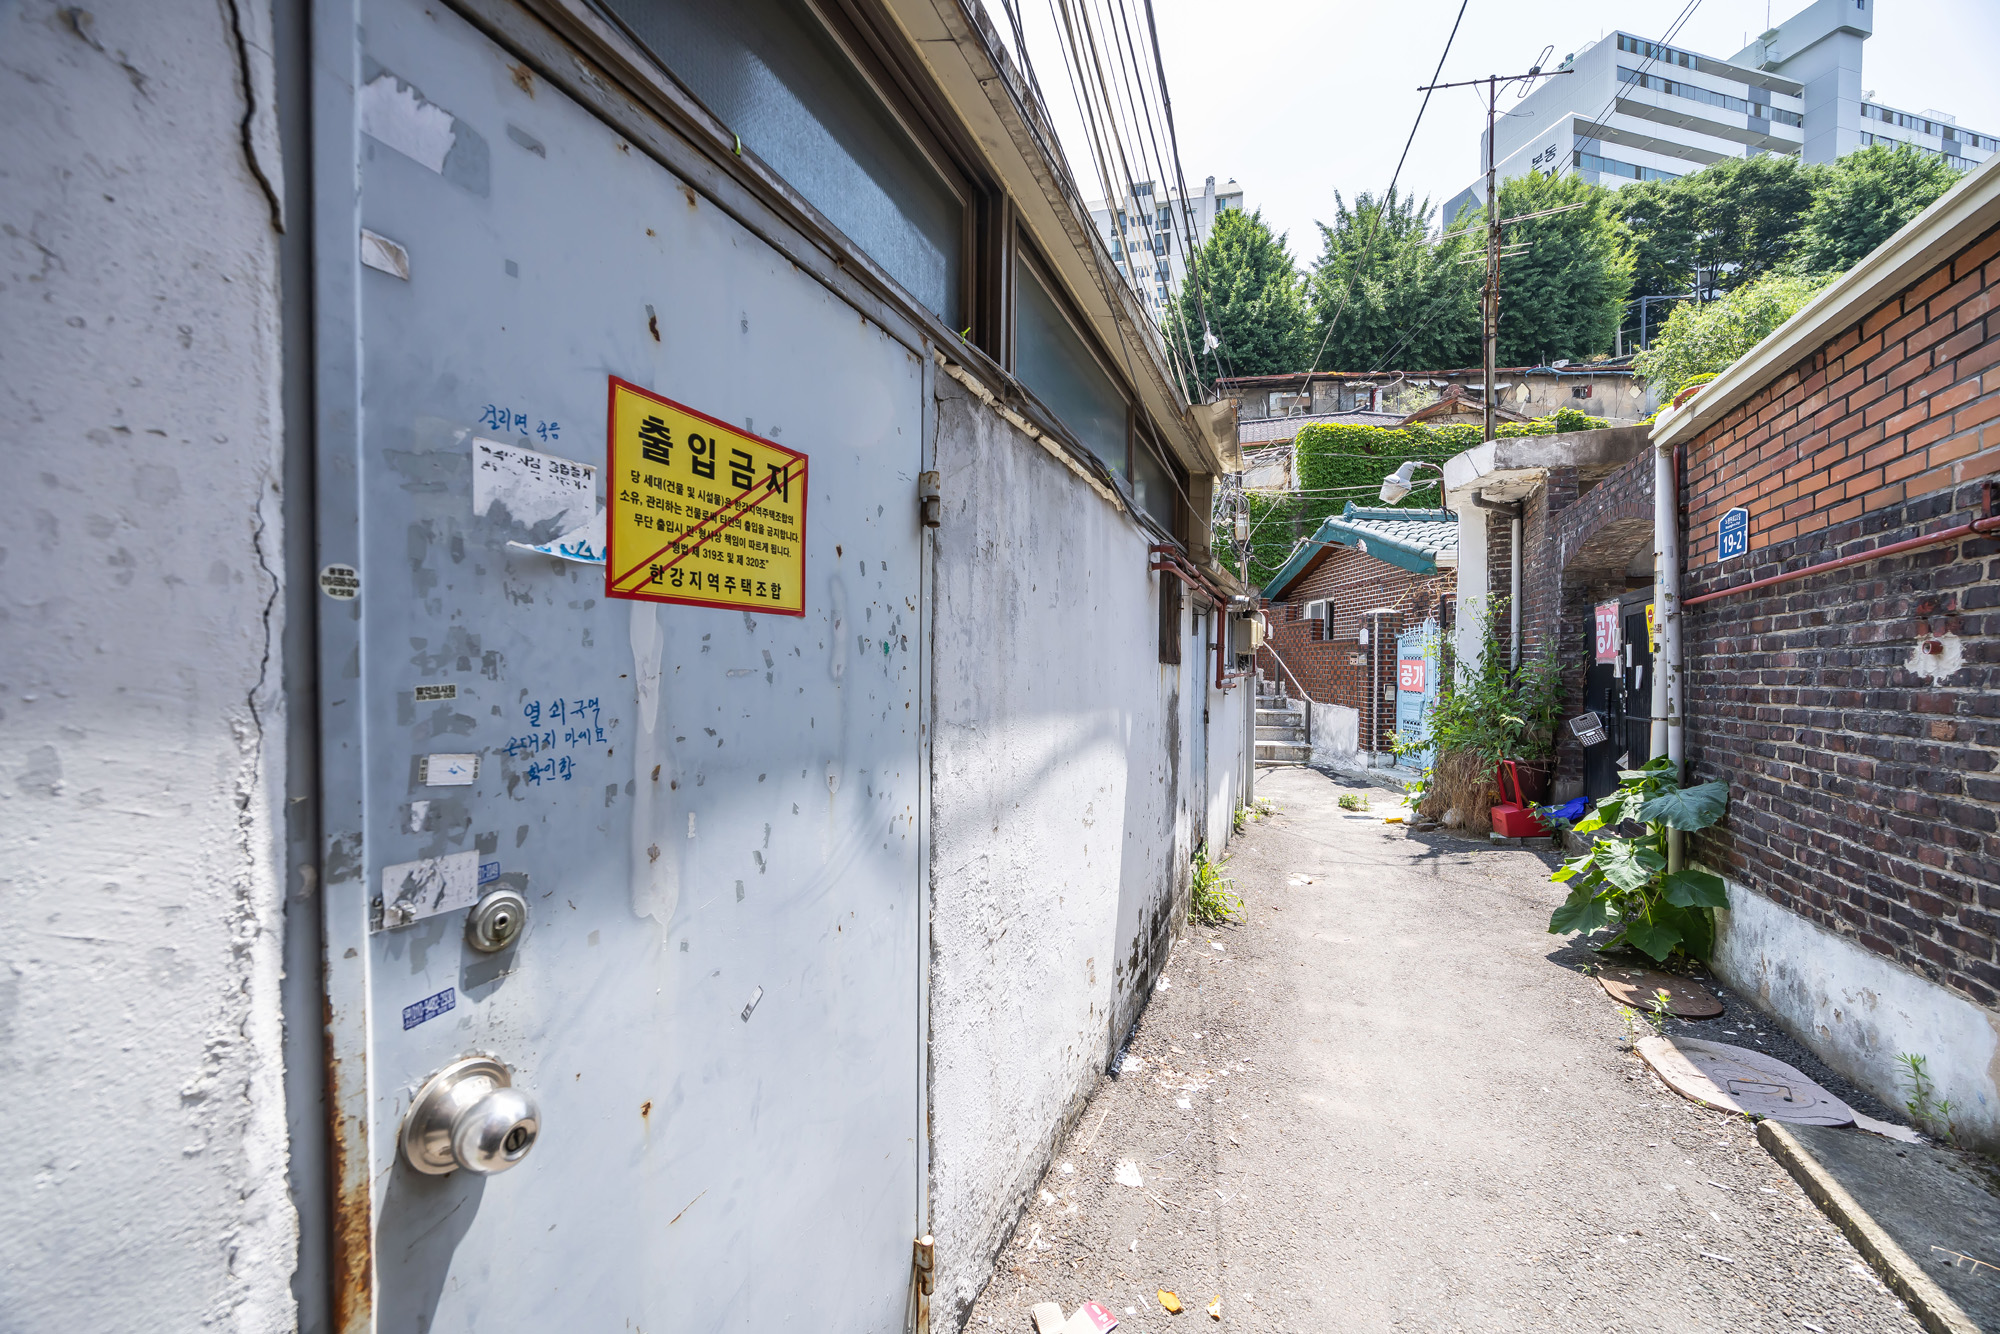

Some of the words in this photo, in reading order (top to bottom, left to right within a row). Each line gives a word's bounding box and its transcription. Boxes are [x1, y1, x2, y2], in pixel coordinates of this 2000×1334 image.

[478, 404, 528, 435] 걸리면
[638, 414, 789, 503] 출입금지
[619, 489, 643, 507] 소유,
[645, 495, 683, 516] 관리하는
[719, 514, 742, 531] 타인의
[744, 520, 765, 536] 출입을
[766, 526, 800, 544] 금지합니다.
[630, 469, 641, 484] 당
[687, 486, 696, 500] 및
[734, 499, 794, 526] 한강지역주택조합의
[633, 513, 654, 529] 무단
[656, 518, 683, 536] 출입시
[724, 533, 746, 549] 책임이
[748, 539, 769, 554] 따르게
[770, 543, 792, 558] 됩니다.
[1723, 530, 1742, 554] 19-2
[691, 545, 700, 559] 제
[702, 548, 725, 562] 319조
[726, 552, 734, 565] 및
[736, 554, 744, 567] 제
[649, 563, 782, 601] 한강지역주택조합
[1596, 612, 1617, 654] 공가
[1401, 664, 1424, 688] 공가
[524, 698, 566, 728] 열쇠
